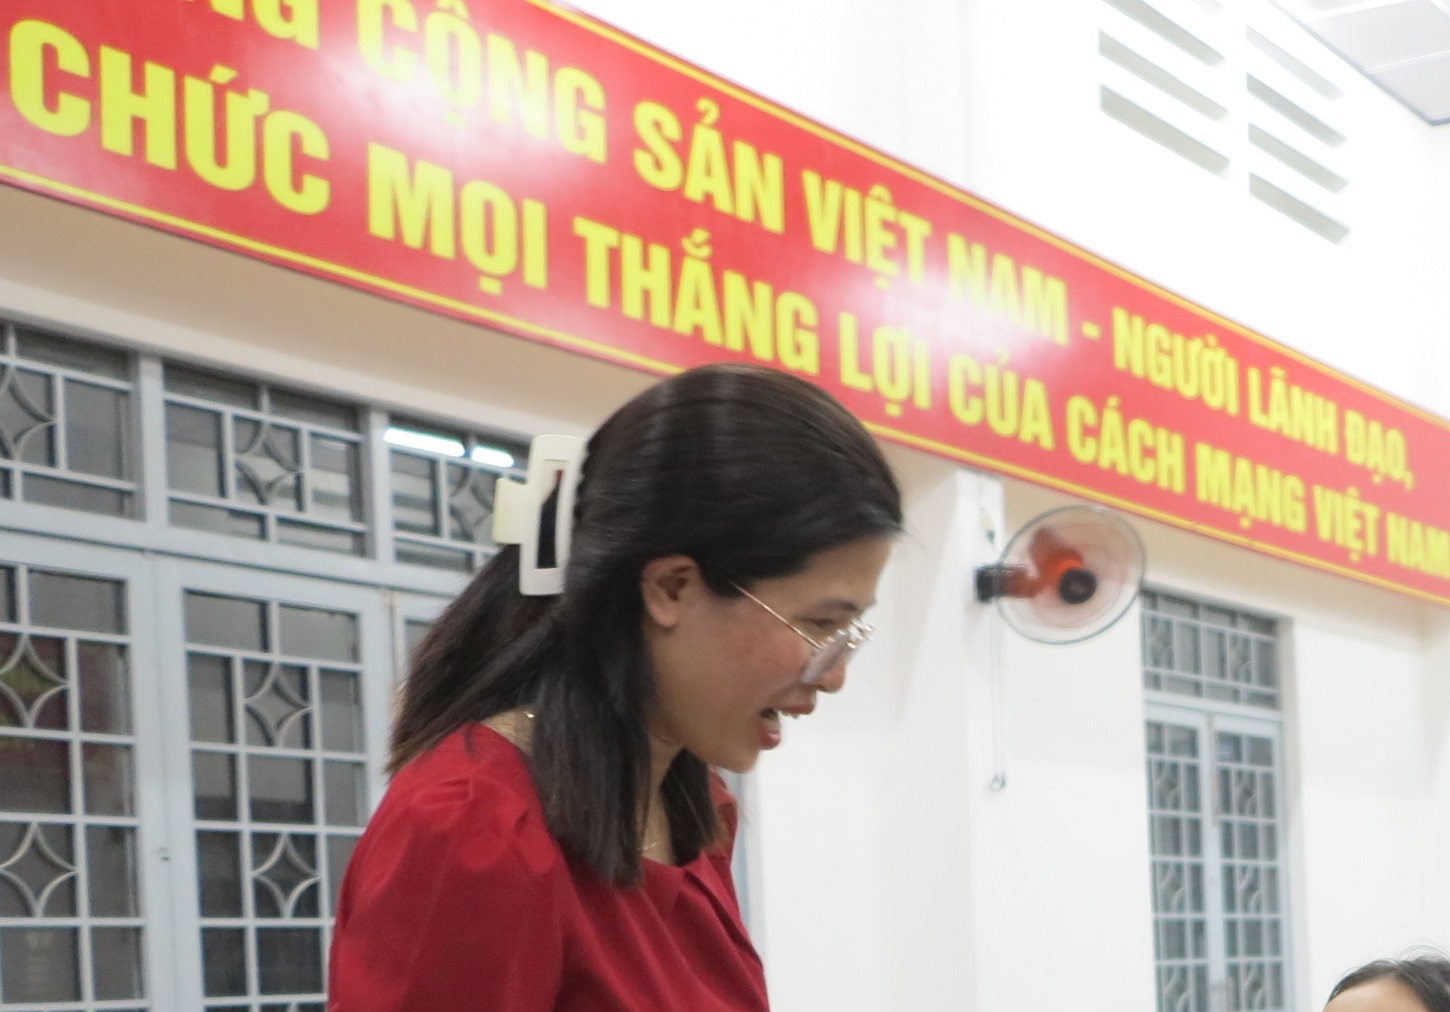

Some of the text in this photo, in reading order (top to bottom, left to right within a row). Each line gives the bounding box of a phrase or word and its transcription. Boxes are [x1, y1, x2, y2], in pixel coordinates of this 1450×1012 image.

[9, 19, 331, 216] CHỨC
[367, 141, 548, 296] MỌI
[573, 215, 820, 376] THẮNG
[838, 310, 934, 418] LỢI
[950, 344, 1055, 451] CỦA
[1065, 395, 1186, 495] CÁCH
[1195, 441, 1306, 534] MẠNG
[1312, 485, 1381, 563] VIỆT
[356, 0, 608, 165] CỘNG
[633, 98, 785, 235] SẢN
[801, 169, 933, 290] VIỆT
[948, 232, 1068, 346] NAM
[1112, 306, 1240, 416] NGƯỜI
[1247, 366, 1340, 456] LÃNH
[1343, 408, 1416, 490] ĐẠO,
